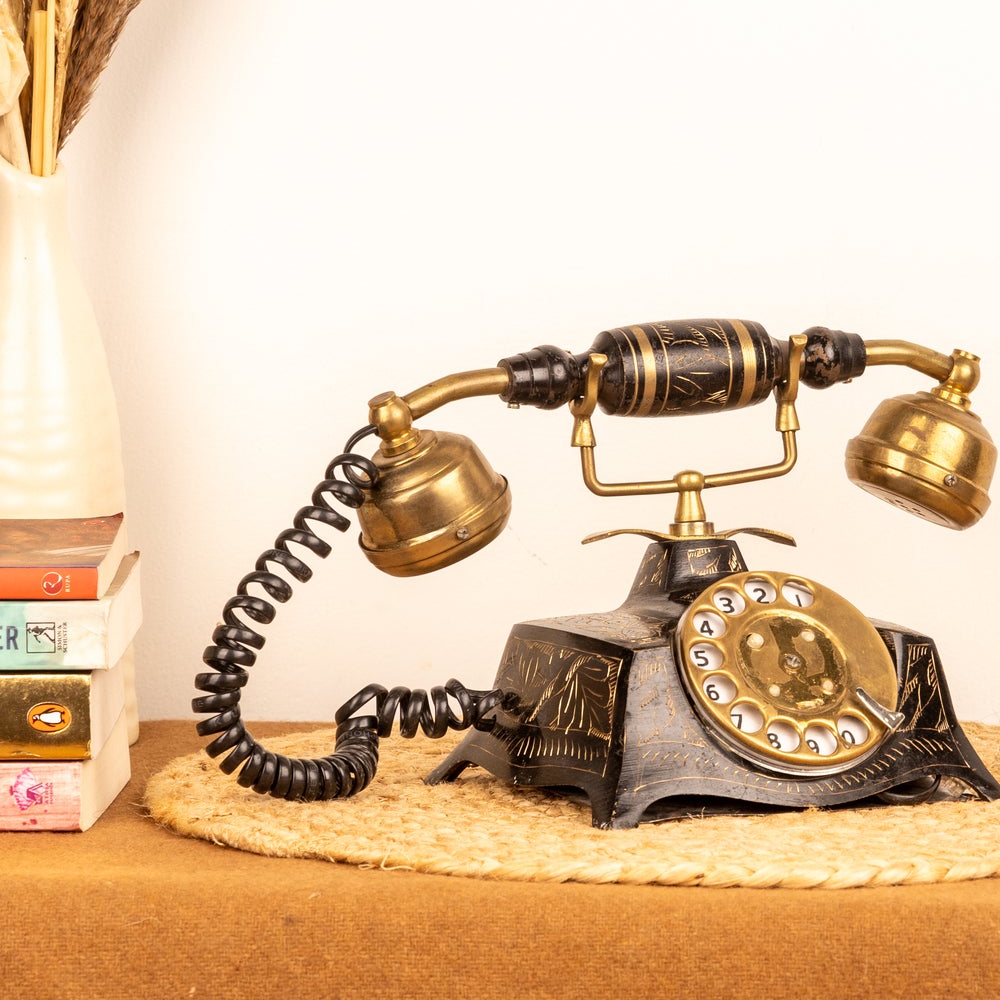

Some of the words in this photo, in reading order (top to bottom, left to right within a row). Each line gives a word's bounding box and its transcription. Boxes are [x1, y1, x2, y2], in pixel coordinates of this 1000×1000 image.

[752, 588, 770, 604] 2
[795, 594, 802, 607] 1
[719, 597, 735, 614] 3
[700, 620, 714, 636] 4
[694, 651, 708, 667] 5
[706, 684, 720, 701] 6
[730, 714, 742, 730] 7
[767, 733, 782, 749] 8
[806, 739, 819, 754] 9
[841, 730, 855, 748] 0
